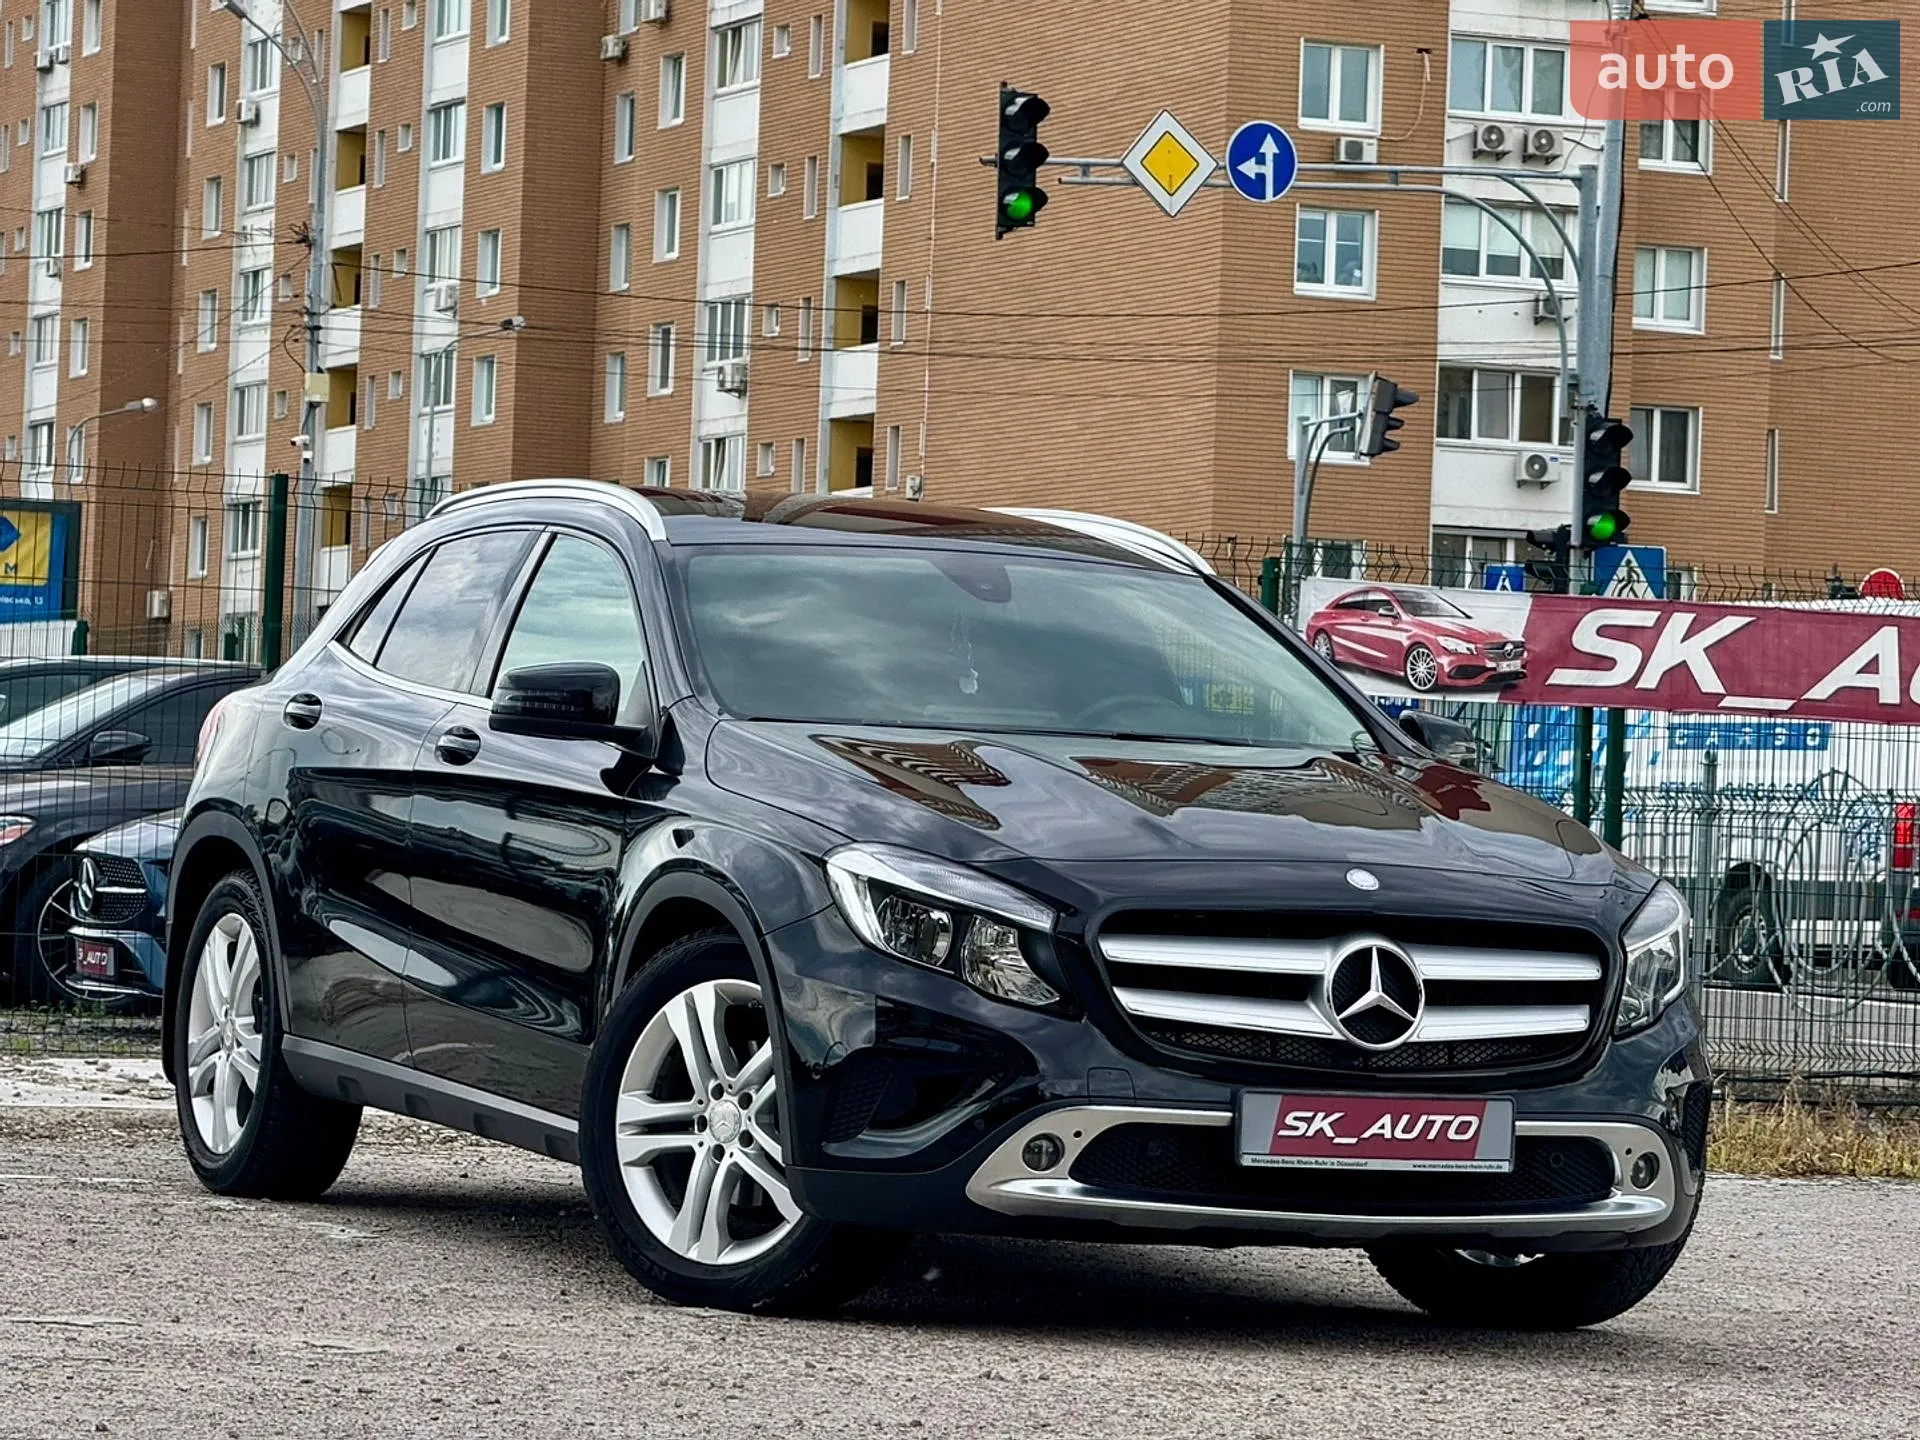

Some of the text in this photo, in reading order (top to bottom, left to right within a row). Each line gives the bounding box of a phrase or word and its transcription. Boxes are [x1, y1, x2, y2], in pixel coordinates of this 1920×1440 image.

[1545, 608, 1920, 712] SK_A
[78, 948, 108, 965] S_AUTO
[1277, 1110, 1479, 1144] SK_AUTO
[1251, 1157, 1295, 1166] Mercedes-Benz
